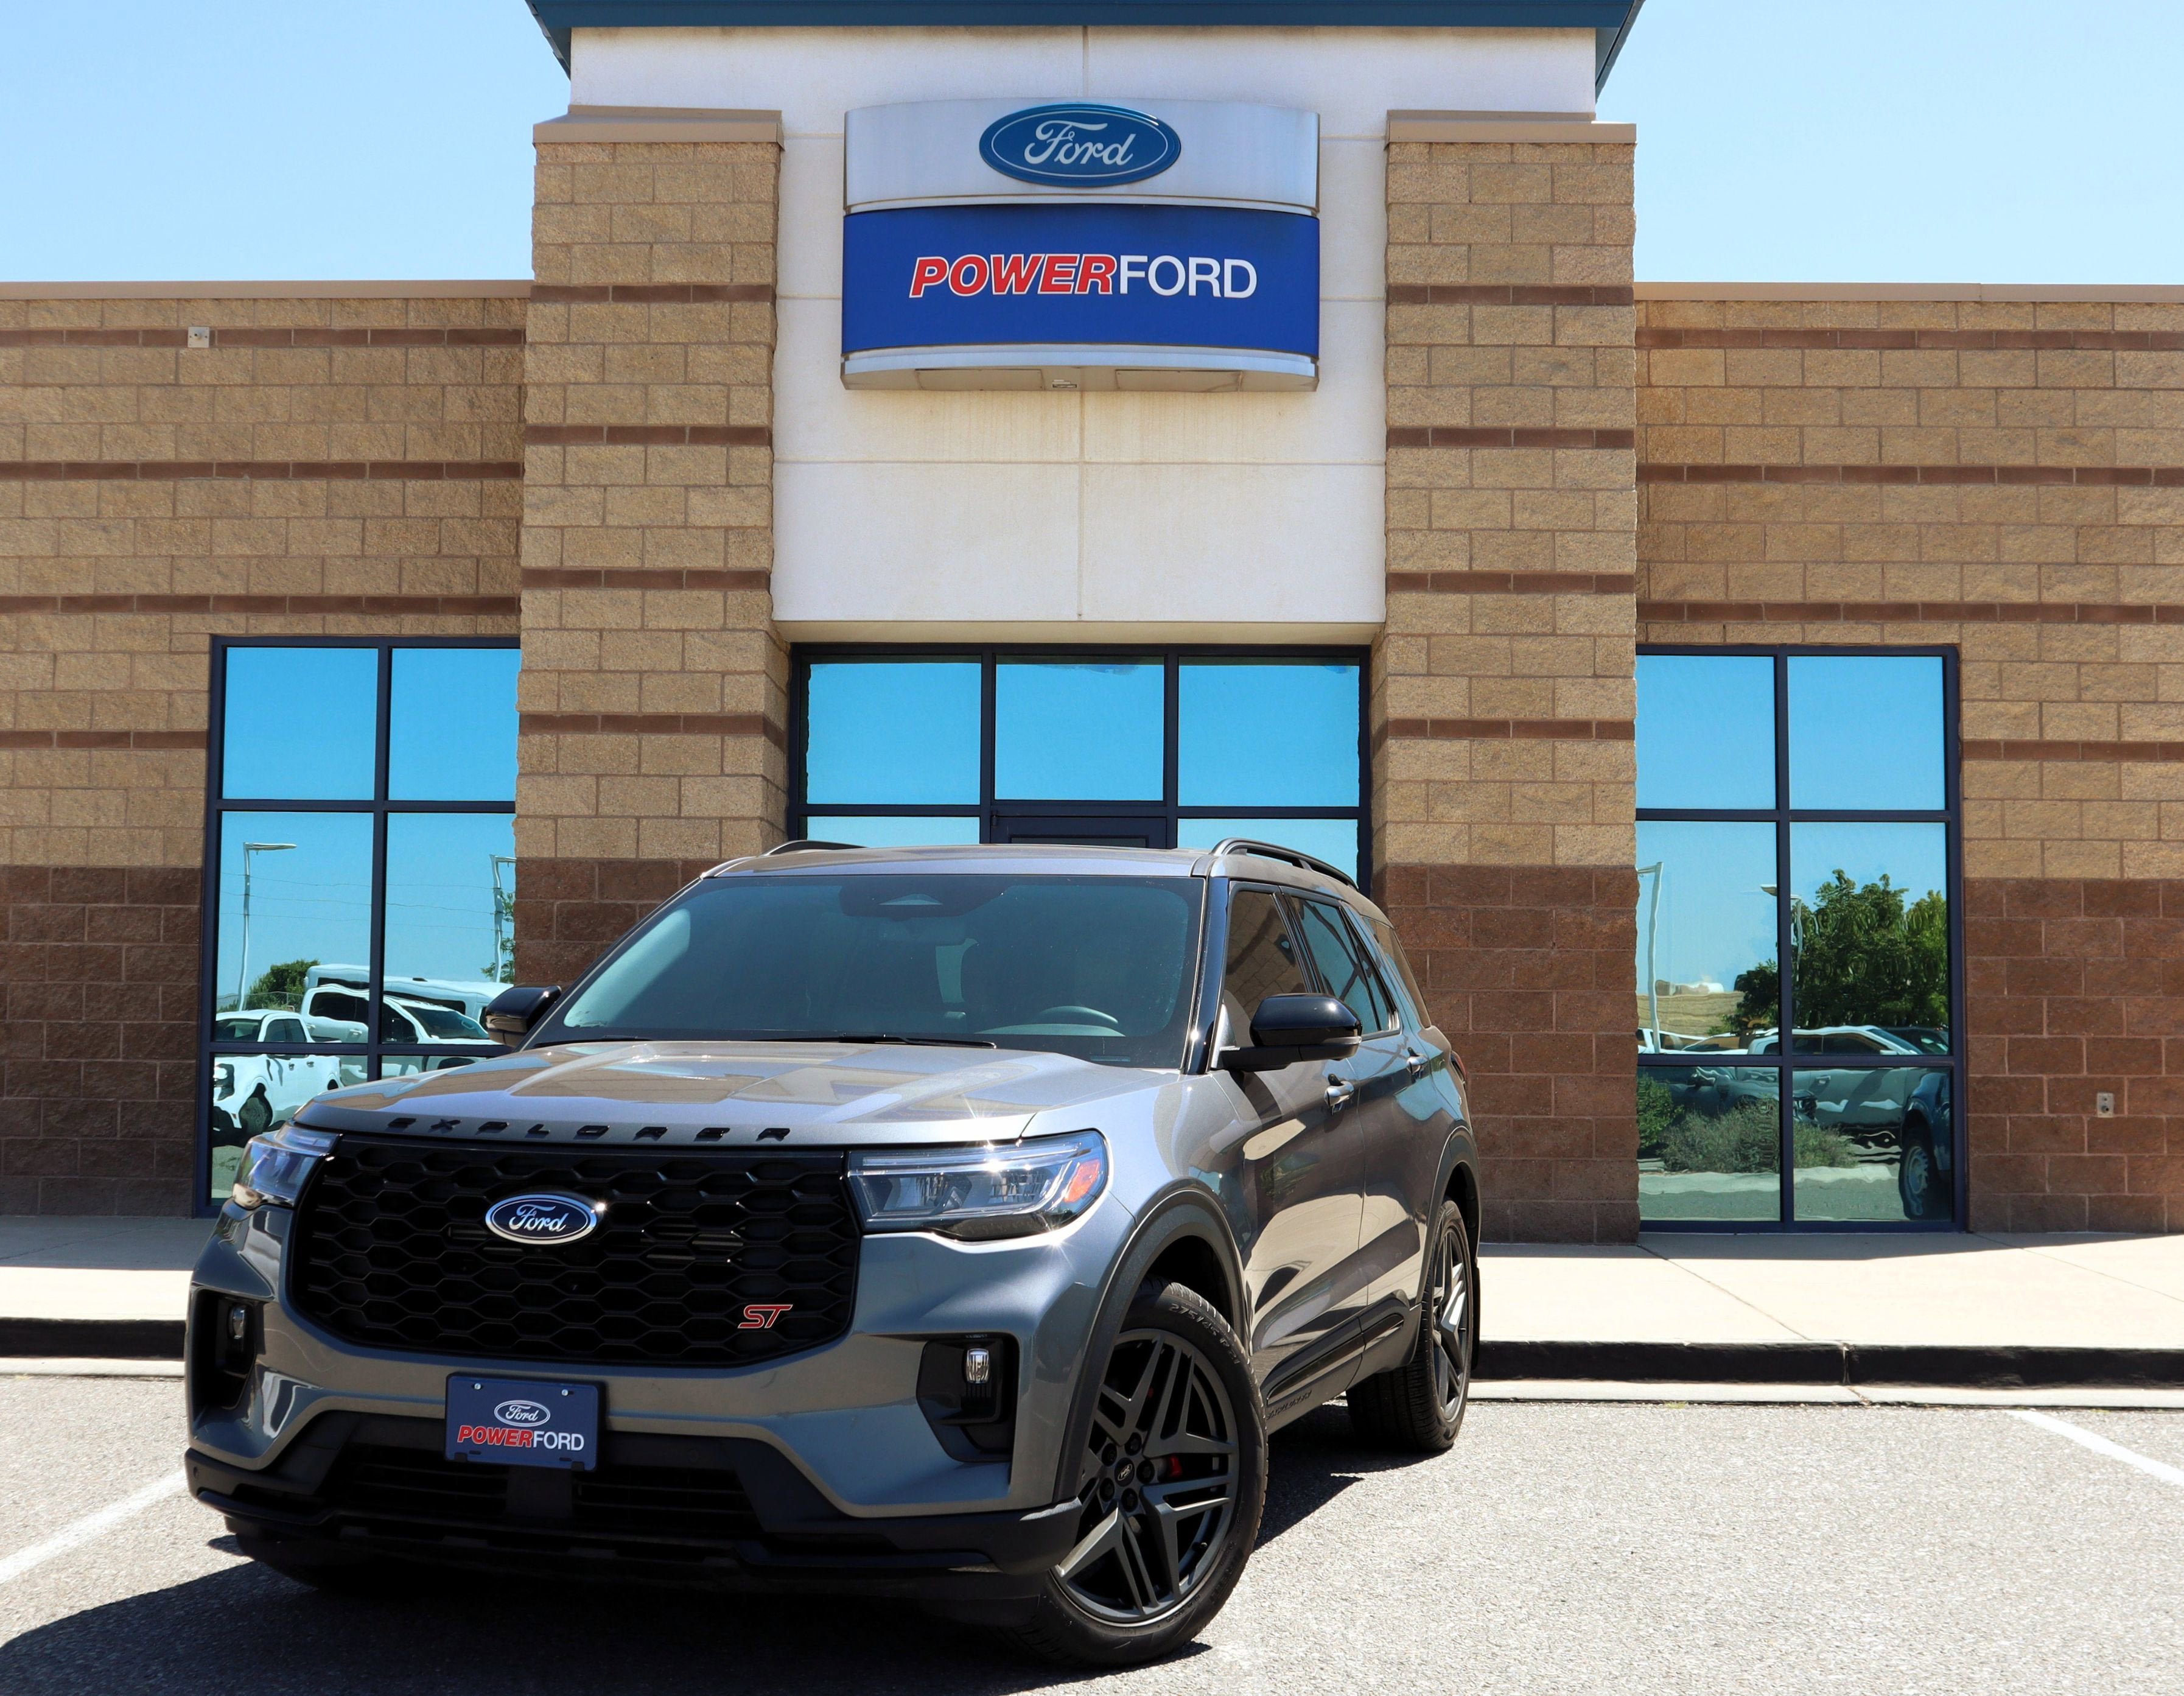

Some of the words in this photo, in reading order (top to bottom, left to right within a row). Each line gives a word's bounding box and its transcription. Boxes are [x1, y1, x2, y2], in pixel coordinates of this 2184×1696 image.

[1024, 121, 1136, 166] Ford
[387, 1117, 790, 1141] EXPLORER
[508, 1204, 569, 1233] Ford
[738, 1304, 793, 1328] ST
[505, 1404, 539, 1421] Ford
